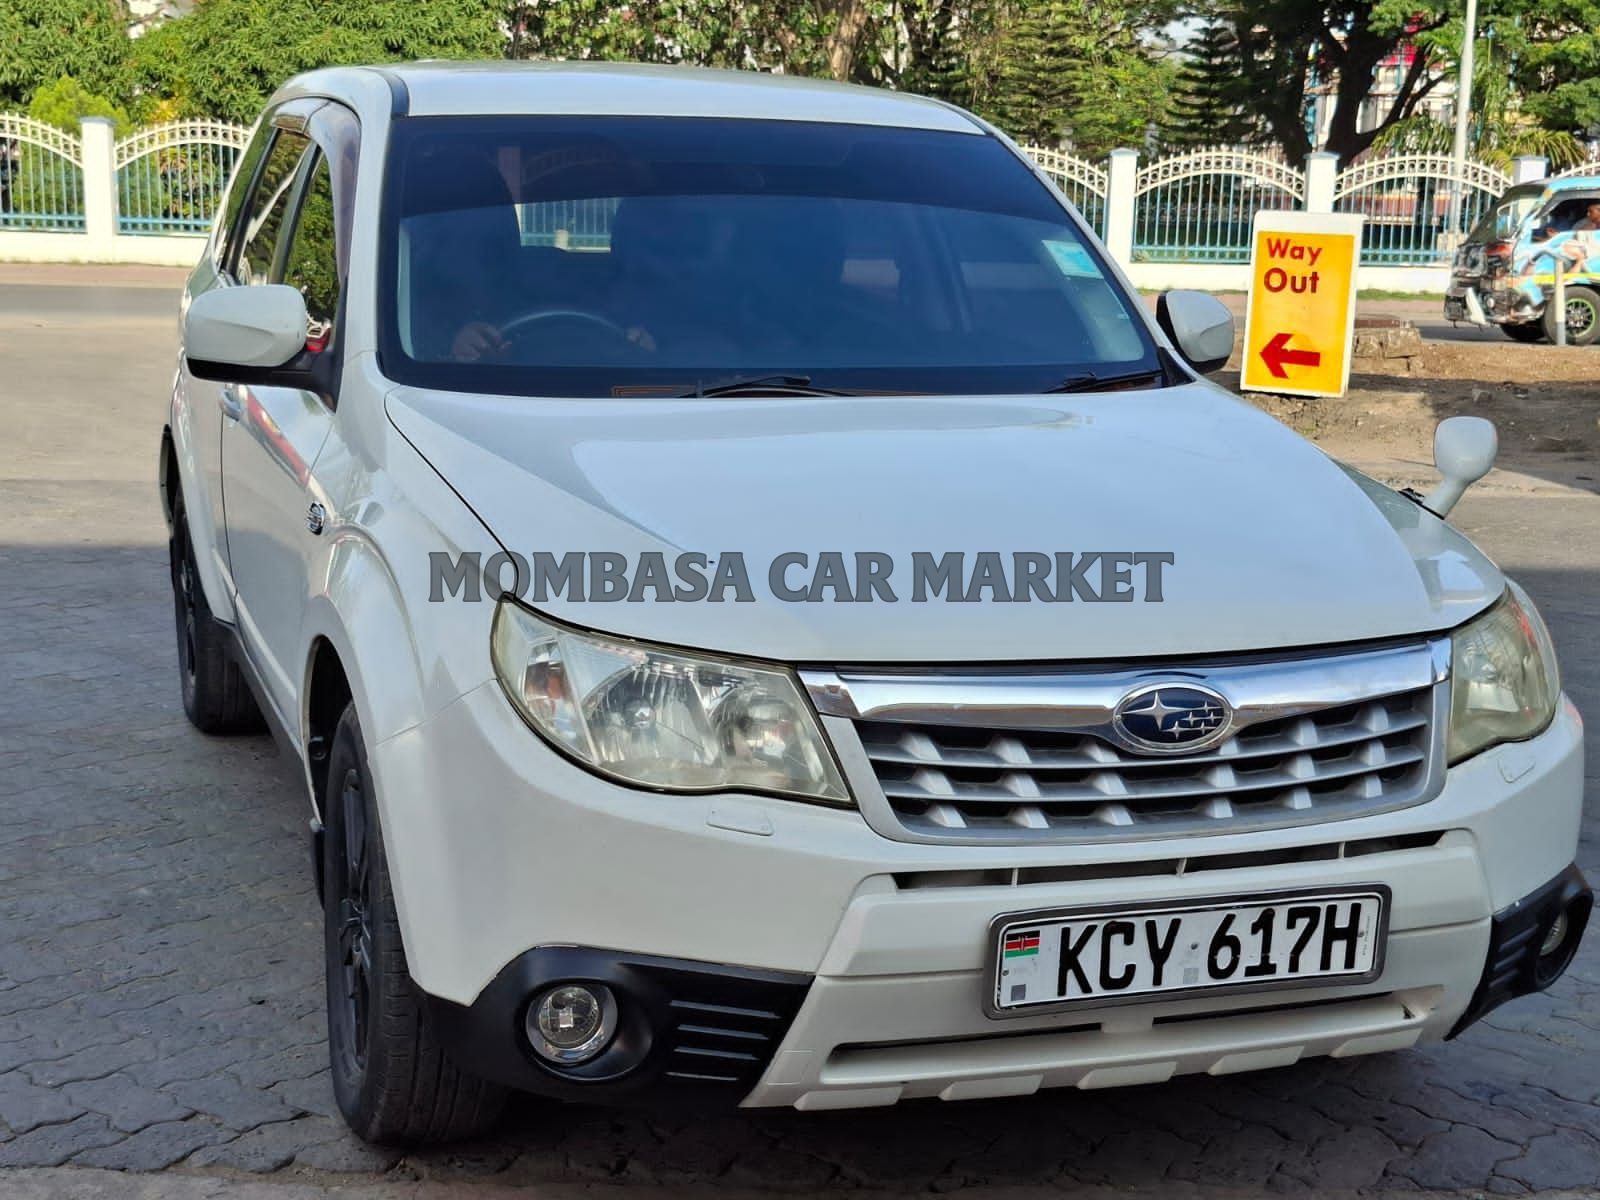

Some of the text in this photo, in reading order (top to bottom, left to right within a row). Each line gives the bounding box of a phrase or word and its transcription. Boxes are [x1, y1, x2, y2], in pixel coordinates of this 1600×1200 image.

[1266, 238, 1322, 266] Way
[1264, 267, 1319, 293] Out
[1057, 918, 1181, 997] KCY
[1207, 903, 1362, 980] 617H
